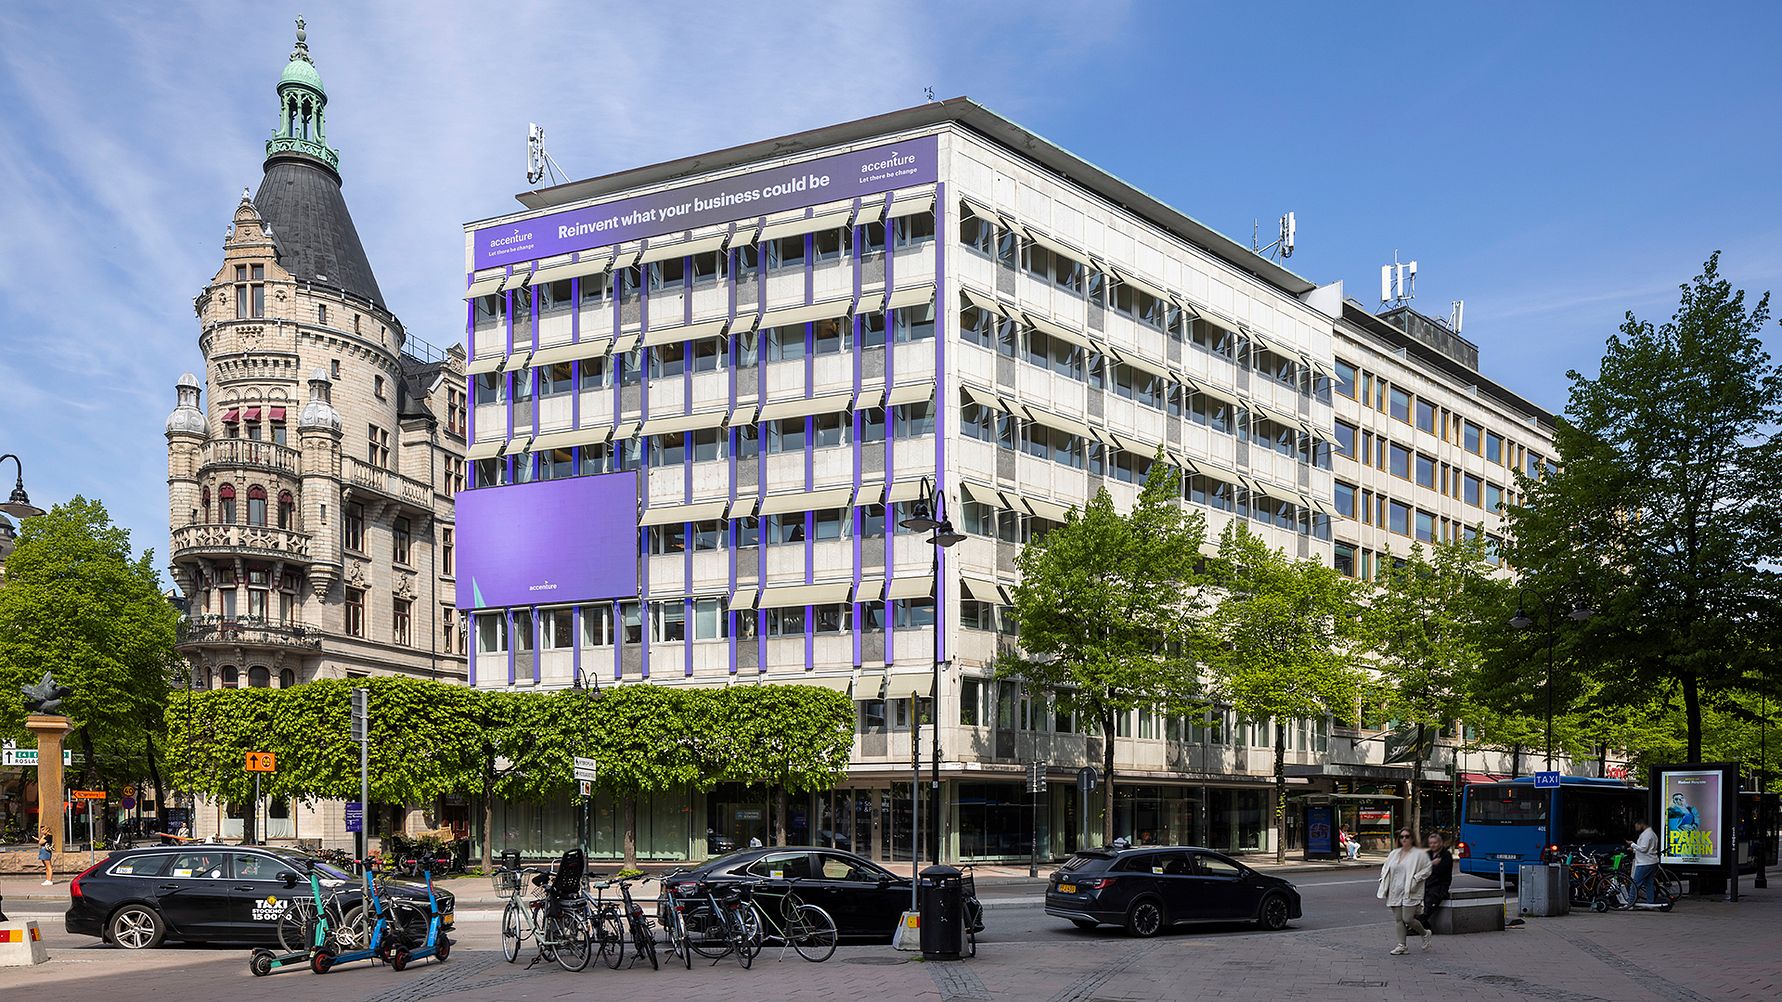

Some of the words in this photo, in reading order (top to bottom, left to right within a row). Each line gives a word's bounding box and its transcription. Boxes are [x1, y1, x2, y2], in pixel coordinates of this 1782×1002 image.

[861, 155, 916, 173] accenture
[895, 168, 918, 176] change
[558, 216, 619, 239] Reinvent
[620, 208, 657, 227] what
[659, 202, 692, 222] your
[694, 189, 761, 213] business
[762, 176, 807, 199] could
[809, 174, 831, 190] be
[490, 232, 533, 248] accenture
[529, 583, 558, 591] accenture
[1536, 776, 1558, 784] TAXI
[1670, 831, 1713, 846] PARK
[1669, 843, 1713, 855] TEATERN
[255, 899, 288, 909] TAXI
